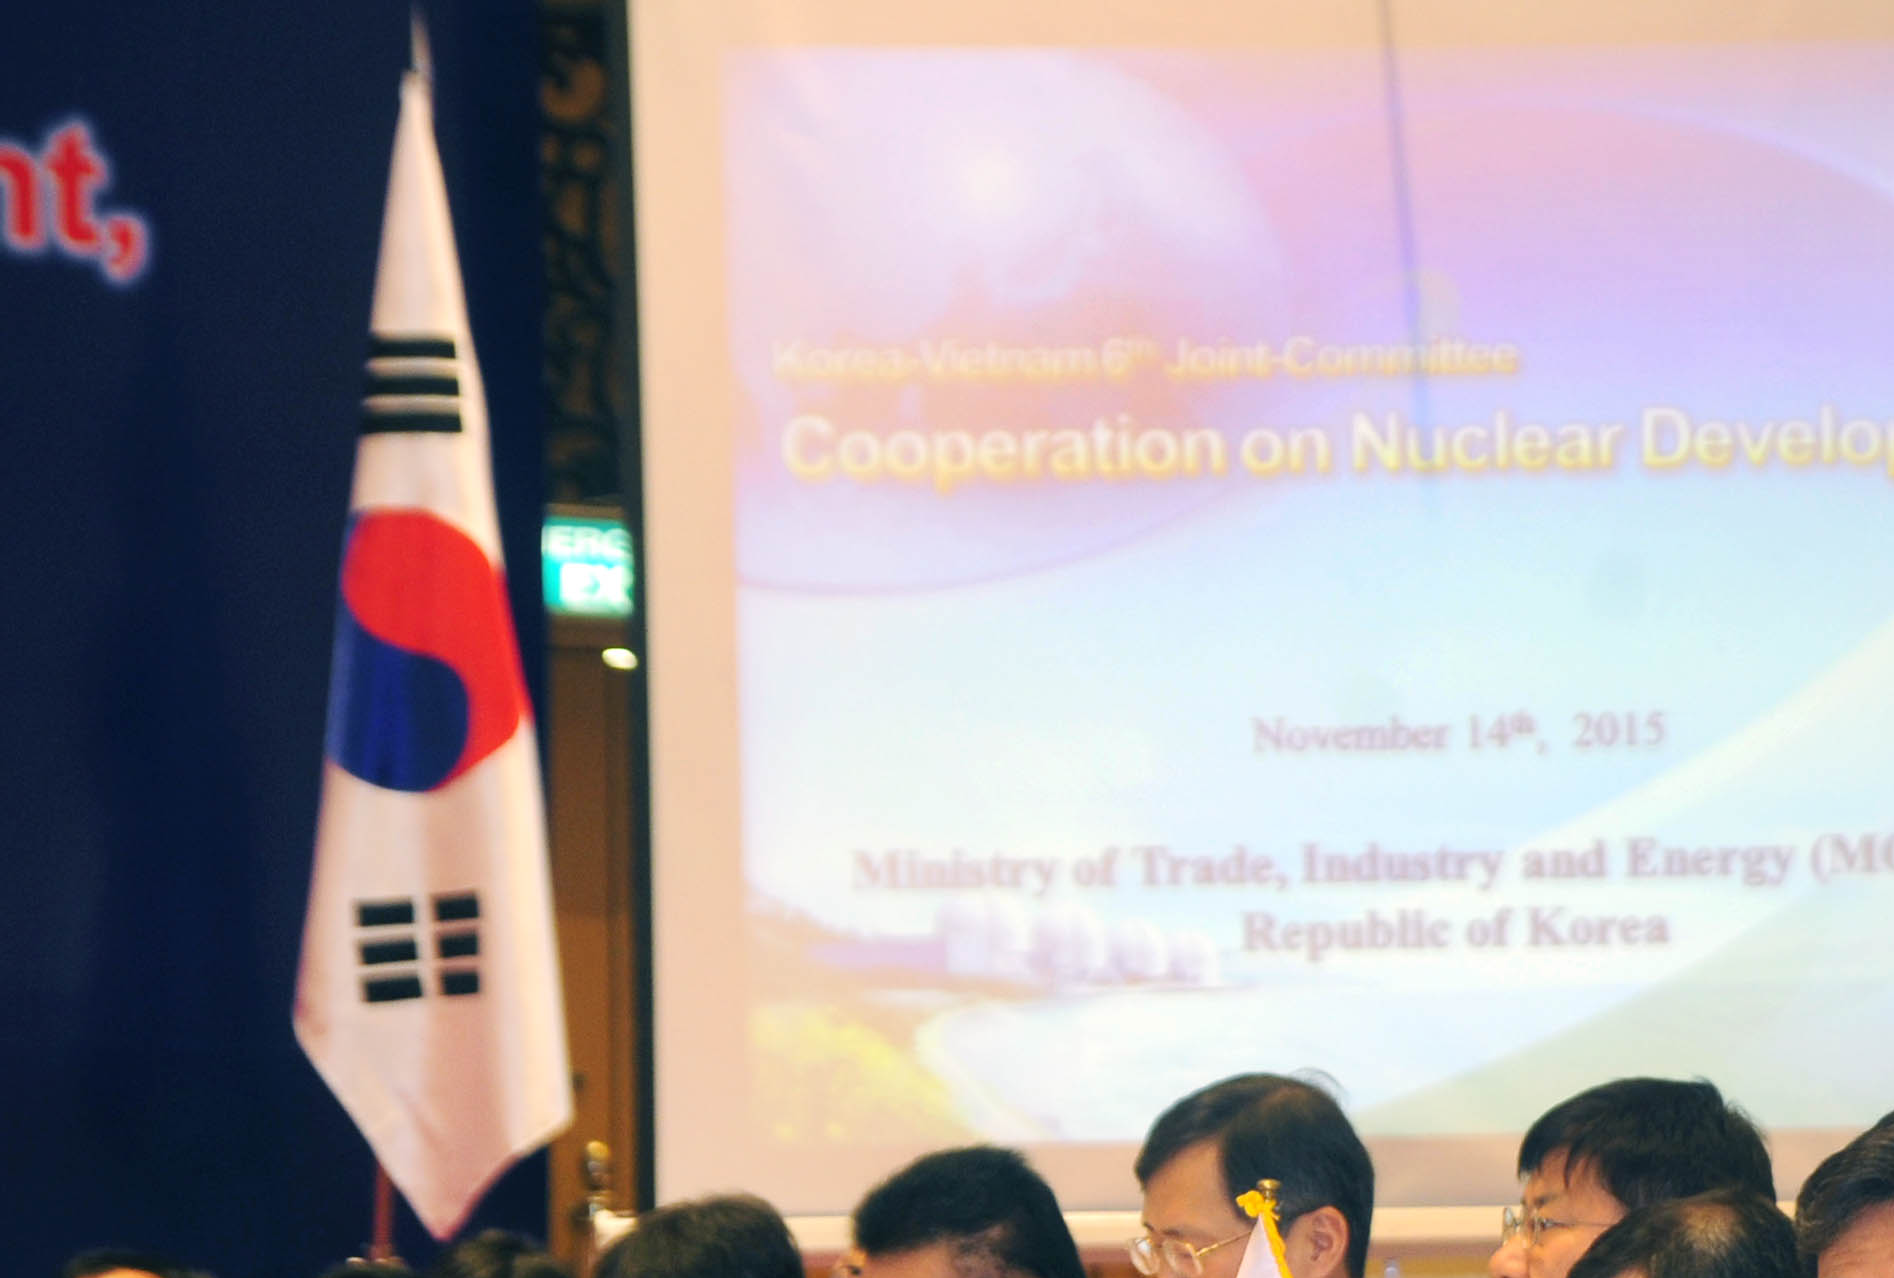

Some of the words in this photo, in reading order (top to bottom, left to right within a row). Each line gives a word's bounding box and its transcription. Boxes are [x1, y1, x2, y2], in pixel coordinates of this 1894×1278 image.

[781, 412, 1229, 496] Cooperation
[1240, 427, 1334, 477] on
[1352, 407, 1624, 477] Nuclear
[1251, 715, 1451, 754] November
[1470, 711, 1548, 756] 14th,
[1573, 710, 1668, 751] 2015
[851, 847, 1058, 898] Ministry
[1072, 846, 1122, 889] of
[1133, 843, 1291, 892] Trade,
[1300, 841, 1504, 891] Industry
[1522, 838, 1609, 881] and
[1625, 834, 1797, 888] Energy
[1242, 908, 1453, 963] Republic
[1465, 906, 1512, 949] of
[1526, 906, 1671, 948] Korea
